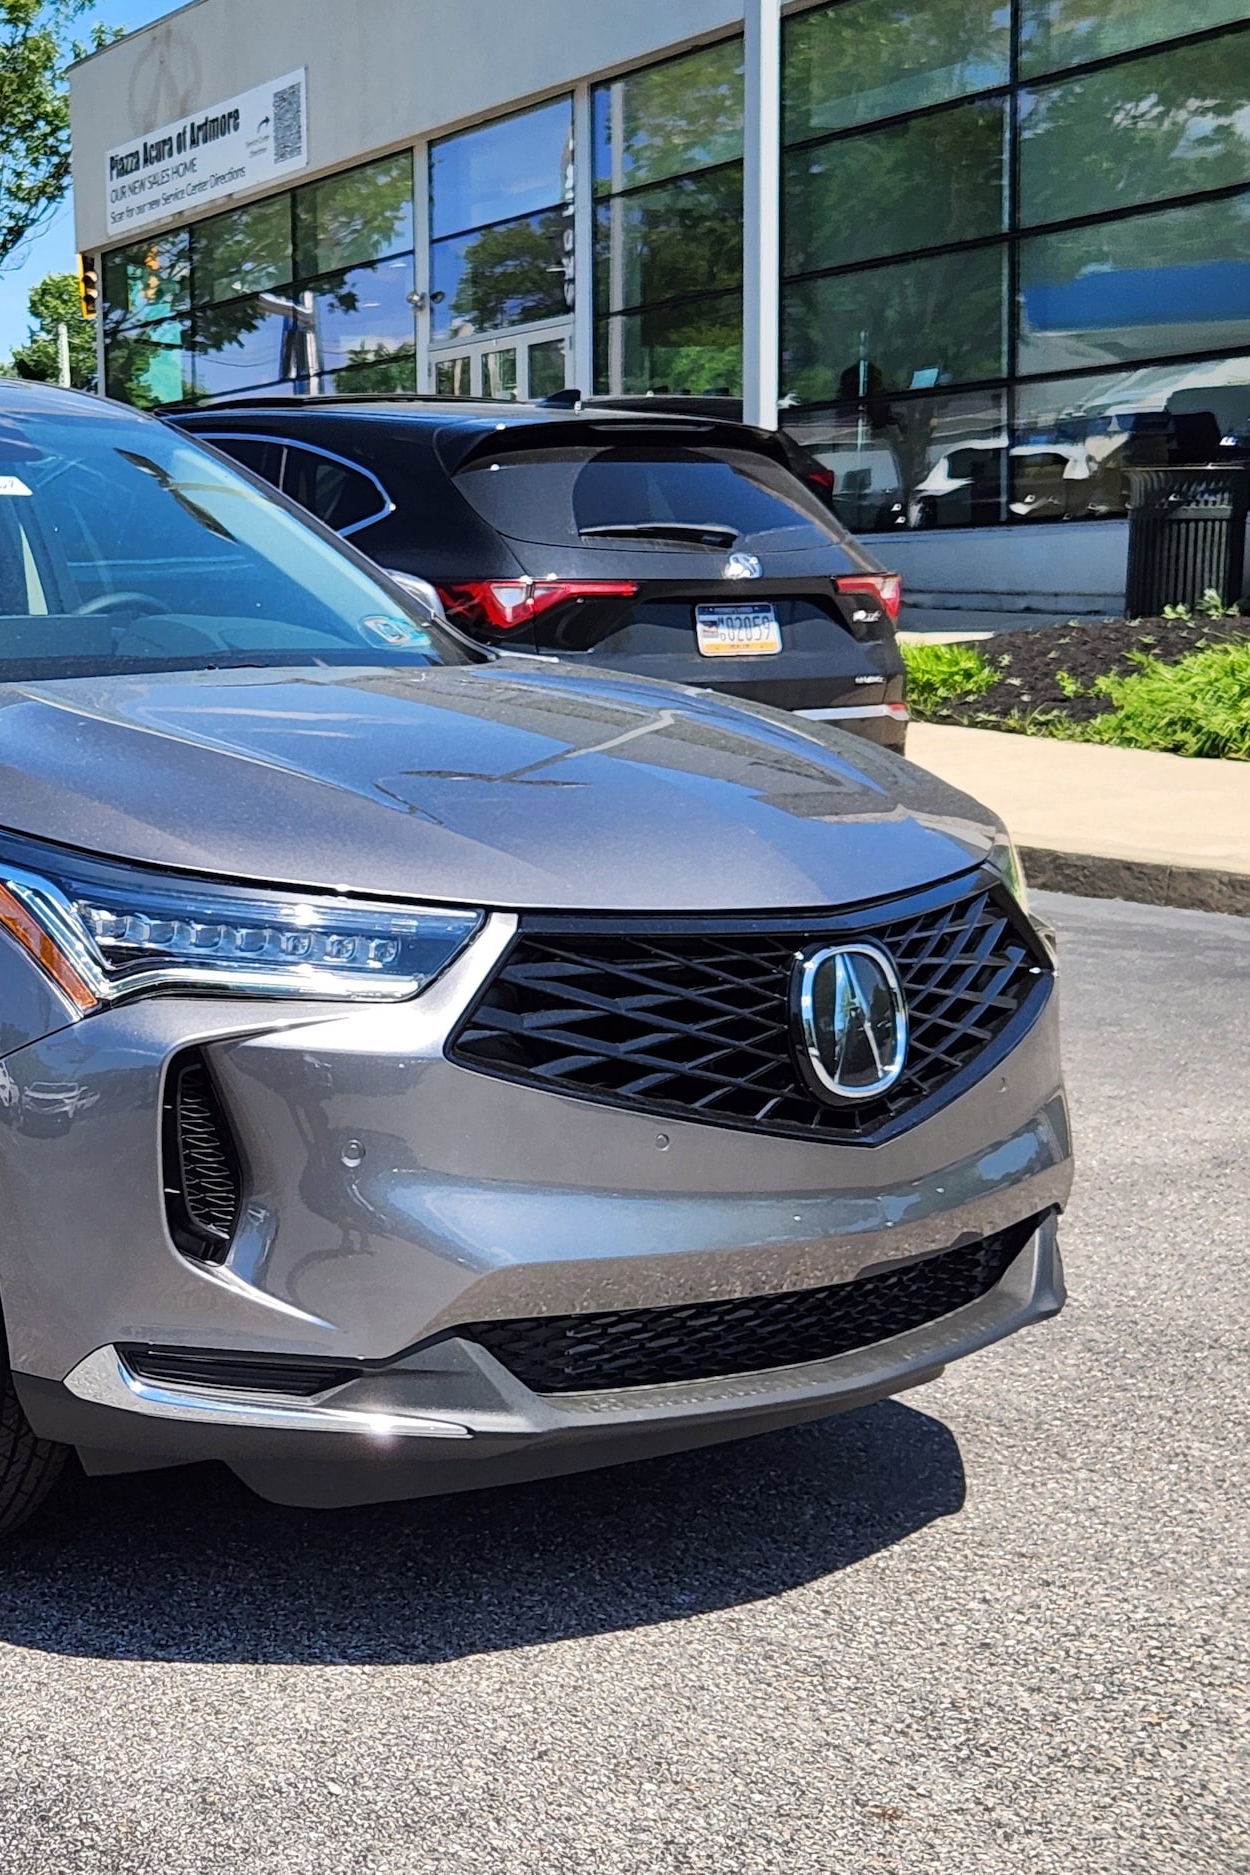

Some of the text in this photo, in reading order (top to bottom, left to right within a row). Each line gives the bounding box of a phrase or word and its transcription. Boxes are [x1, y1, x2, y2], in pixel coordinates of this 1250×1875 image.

[110, 150, 140, 182] Piazza
[143, 136, 173, 168] Acura
[176, 125, 187, 155] of
[190, 108, 239, 150] Ardmore
[110, 157, 198, 204] OUR NEW SALES HOME
[161, 188, 186, 206] Service
[186, 182, 209, 197] Center
[209, 167, 246, 188] Directions
[726, 616, 771, 642] 02059
